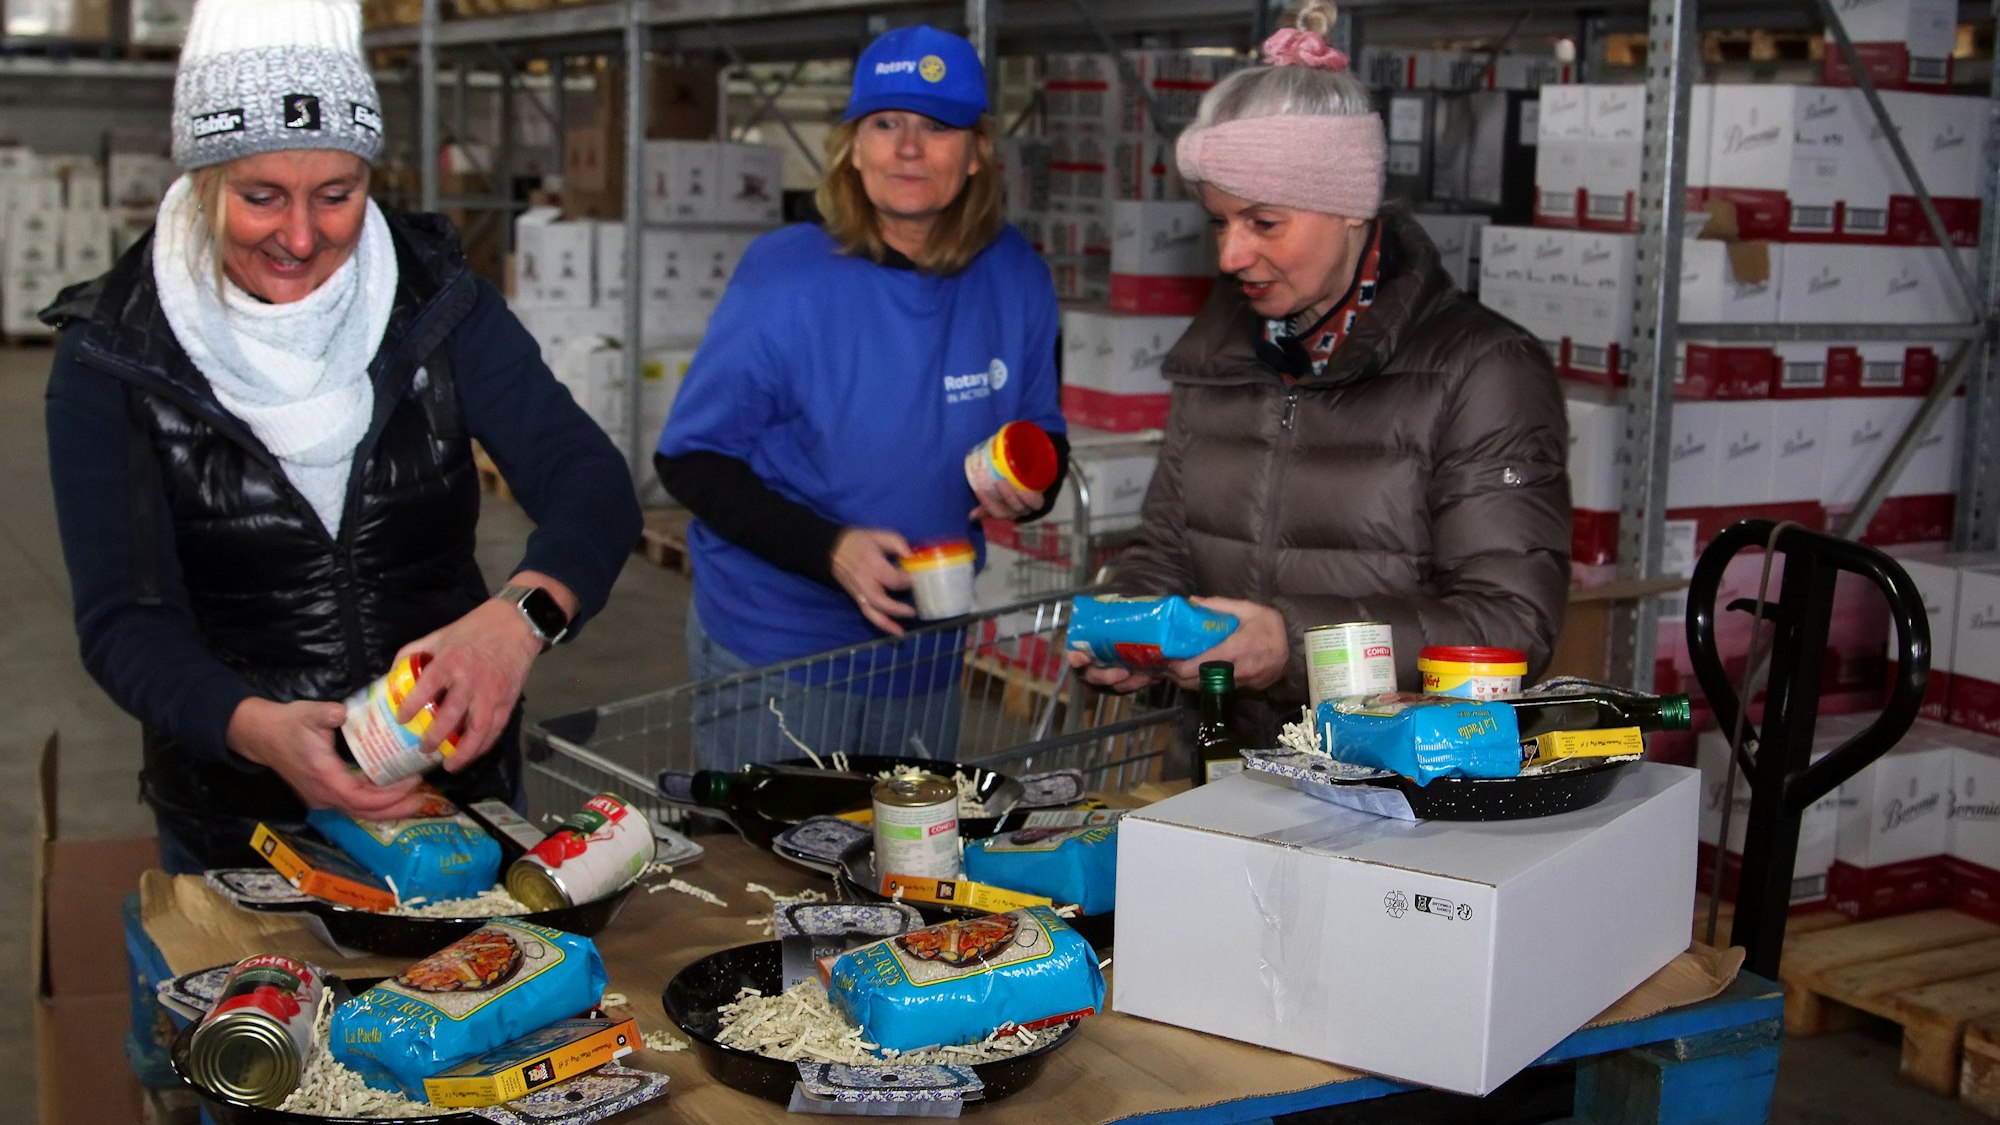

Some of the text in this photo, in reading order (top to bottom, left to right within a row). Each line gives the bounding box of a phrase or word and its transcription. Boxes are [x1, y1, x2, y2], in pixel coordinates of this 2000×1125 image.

[875, 61, 917, 76] Rotary
[944, 373, 989, 391] Rotary
[357, 1026, 383, 1044] Paella
